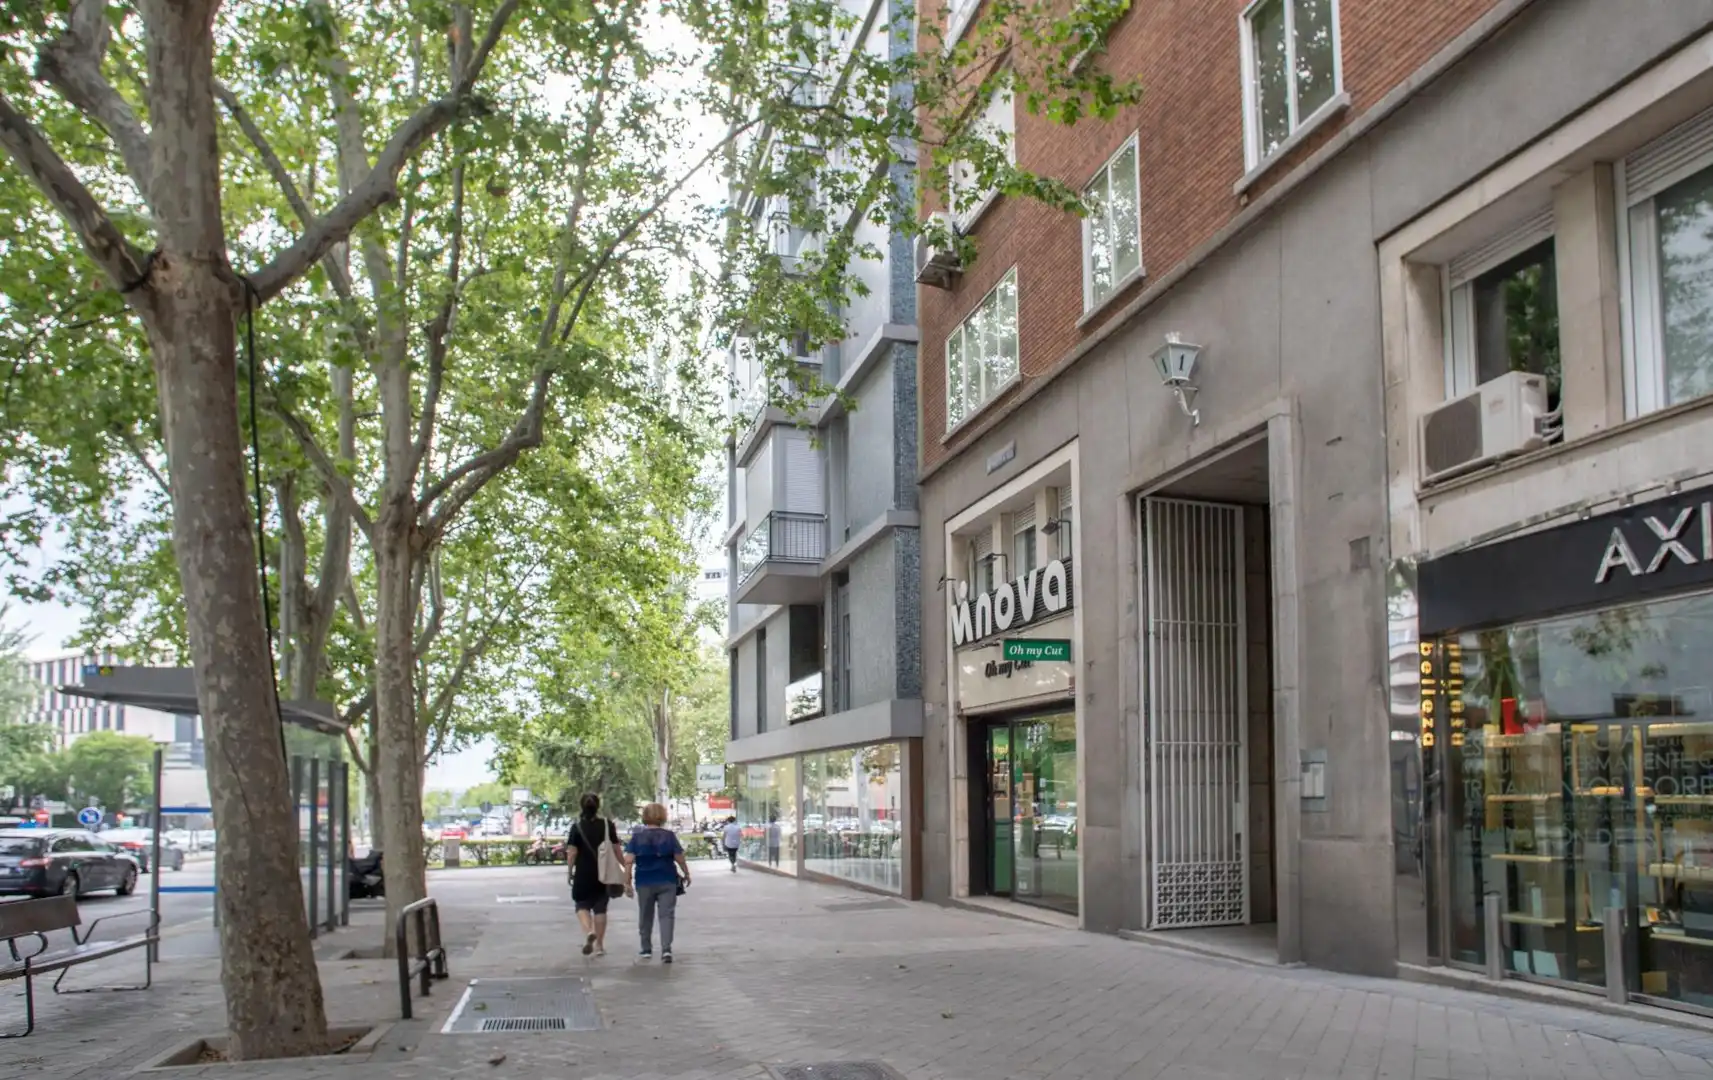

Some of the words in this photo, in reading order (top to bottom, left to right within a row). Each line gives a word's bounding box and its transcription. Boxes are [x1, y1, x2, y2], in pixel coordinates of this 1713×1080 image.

[1009, 644, 1024, 655] Oh
[1026, 646, 1042, 658] my
[1044, 645, 1063, 656] Cut
[1420, 642, 1437, 748] belleza
